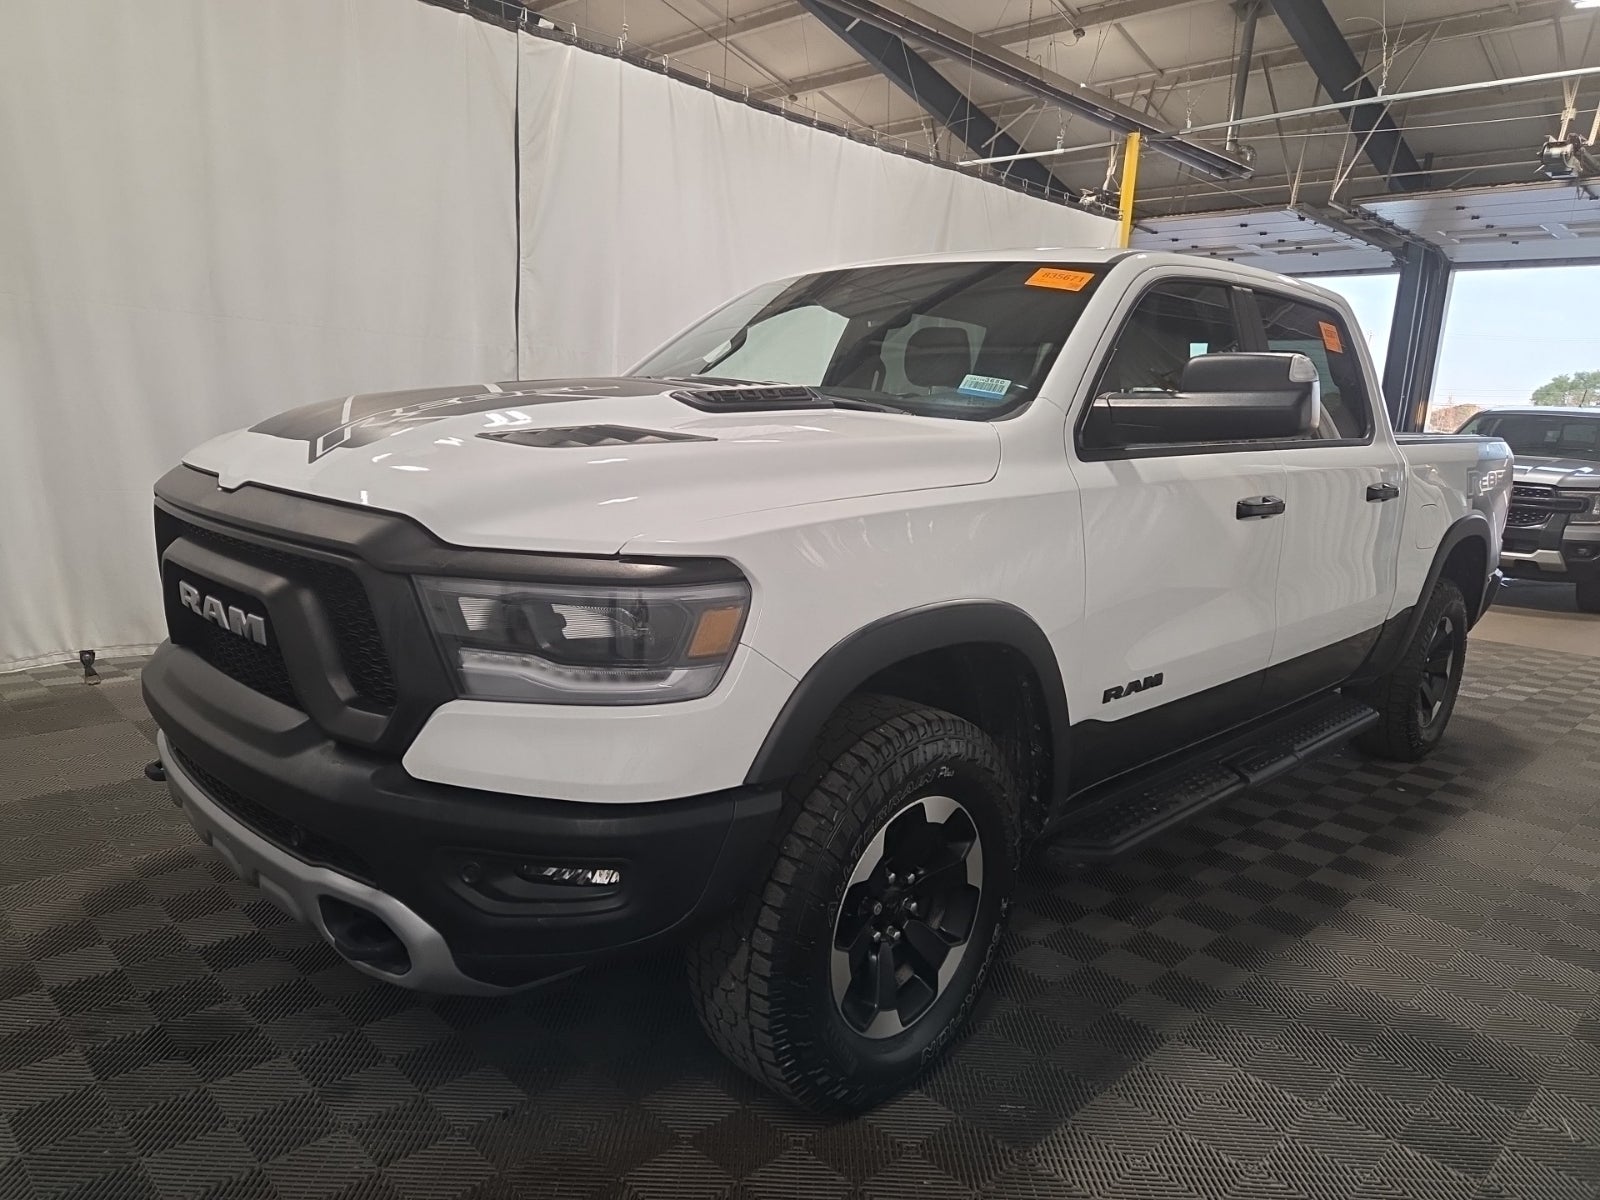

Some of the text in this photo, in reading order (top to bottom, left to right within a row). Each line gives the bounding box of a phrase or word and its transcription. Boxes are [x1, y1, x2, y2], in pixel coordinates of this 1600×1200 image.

[1041, 272, 1086, 283] 835671
[179, 580, 267, 646] RAM
[1102, 672, 1164, 704] RAM
